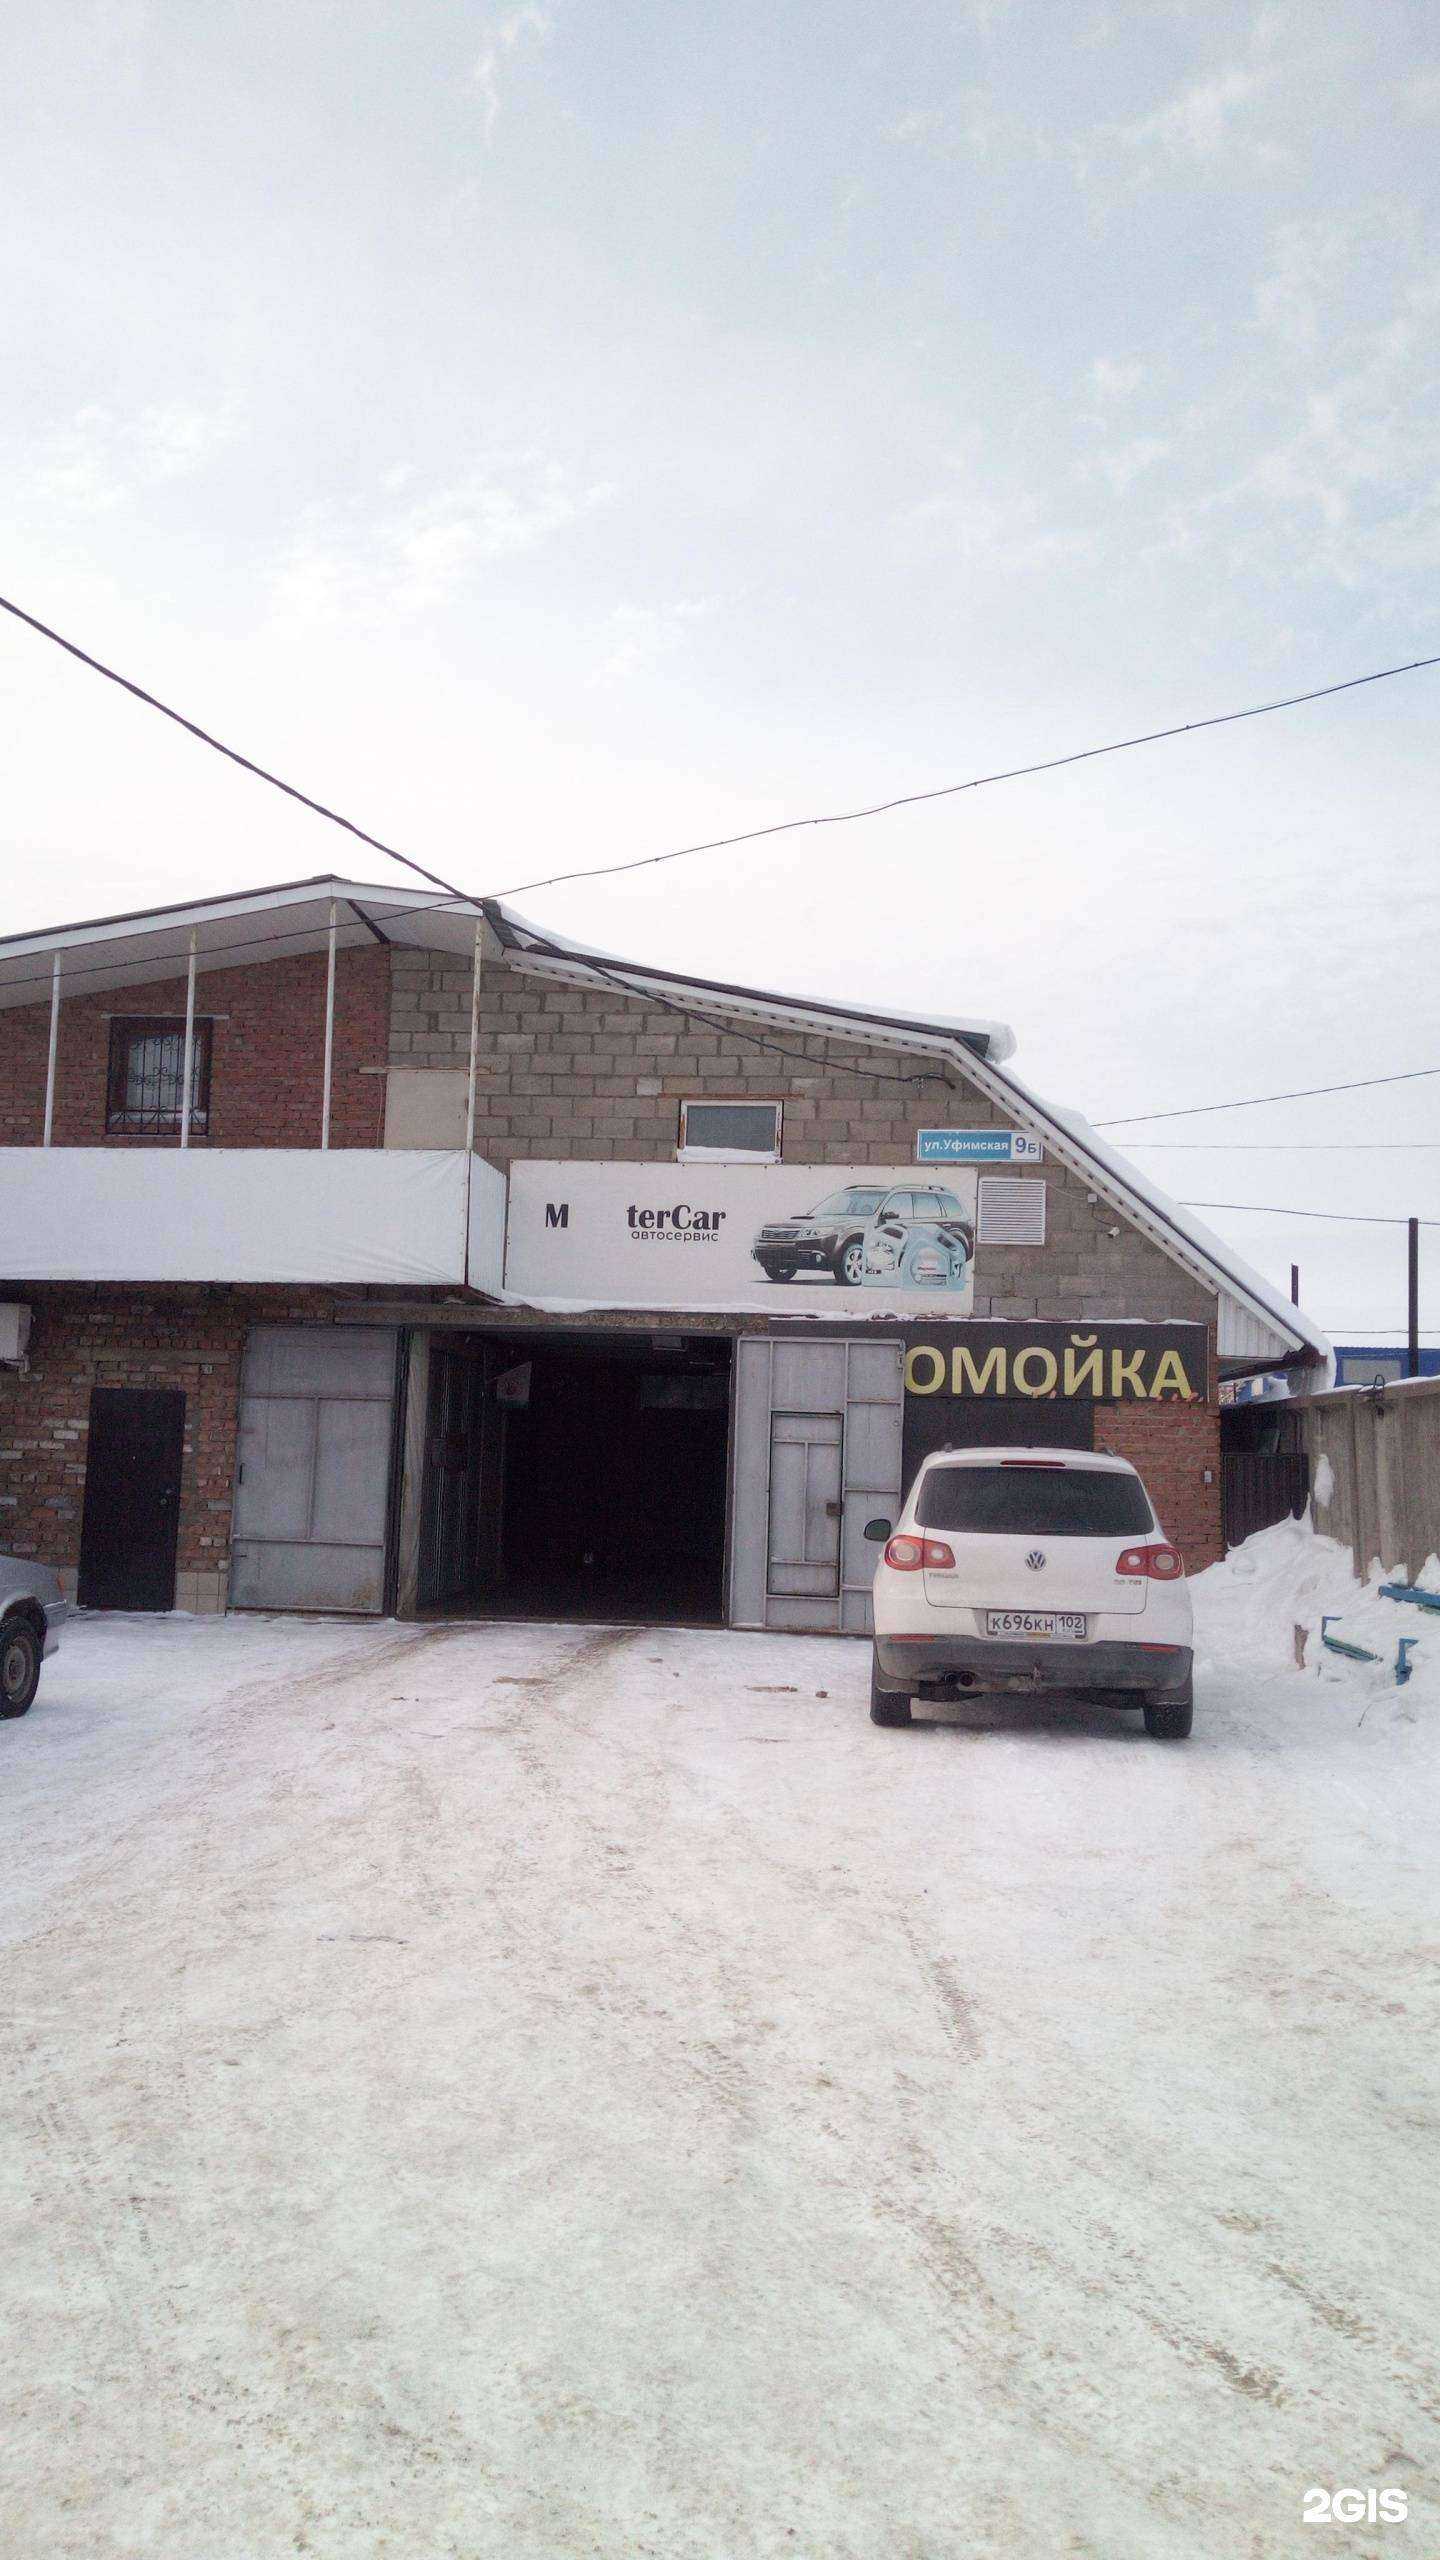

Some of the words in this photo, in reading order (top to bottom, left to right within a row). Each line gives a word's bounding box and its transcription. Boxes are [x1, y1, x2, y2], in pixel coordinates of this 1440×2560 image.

[626, 1204, 727, 1231] terCar
[631, 1230, 719, 1243] автосервис
[1058, 1616, 1083, 1629] 102
